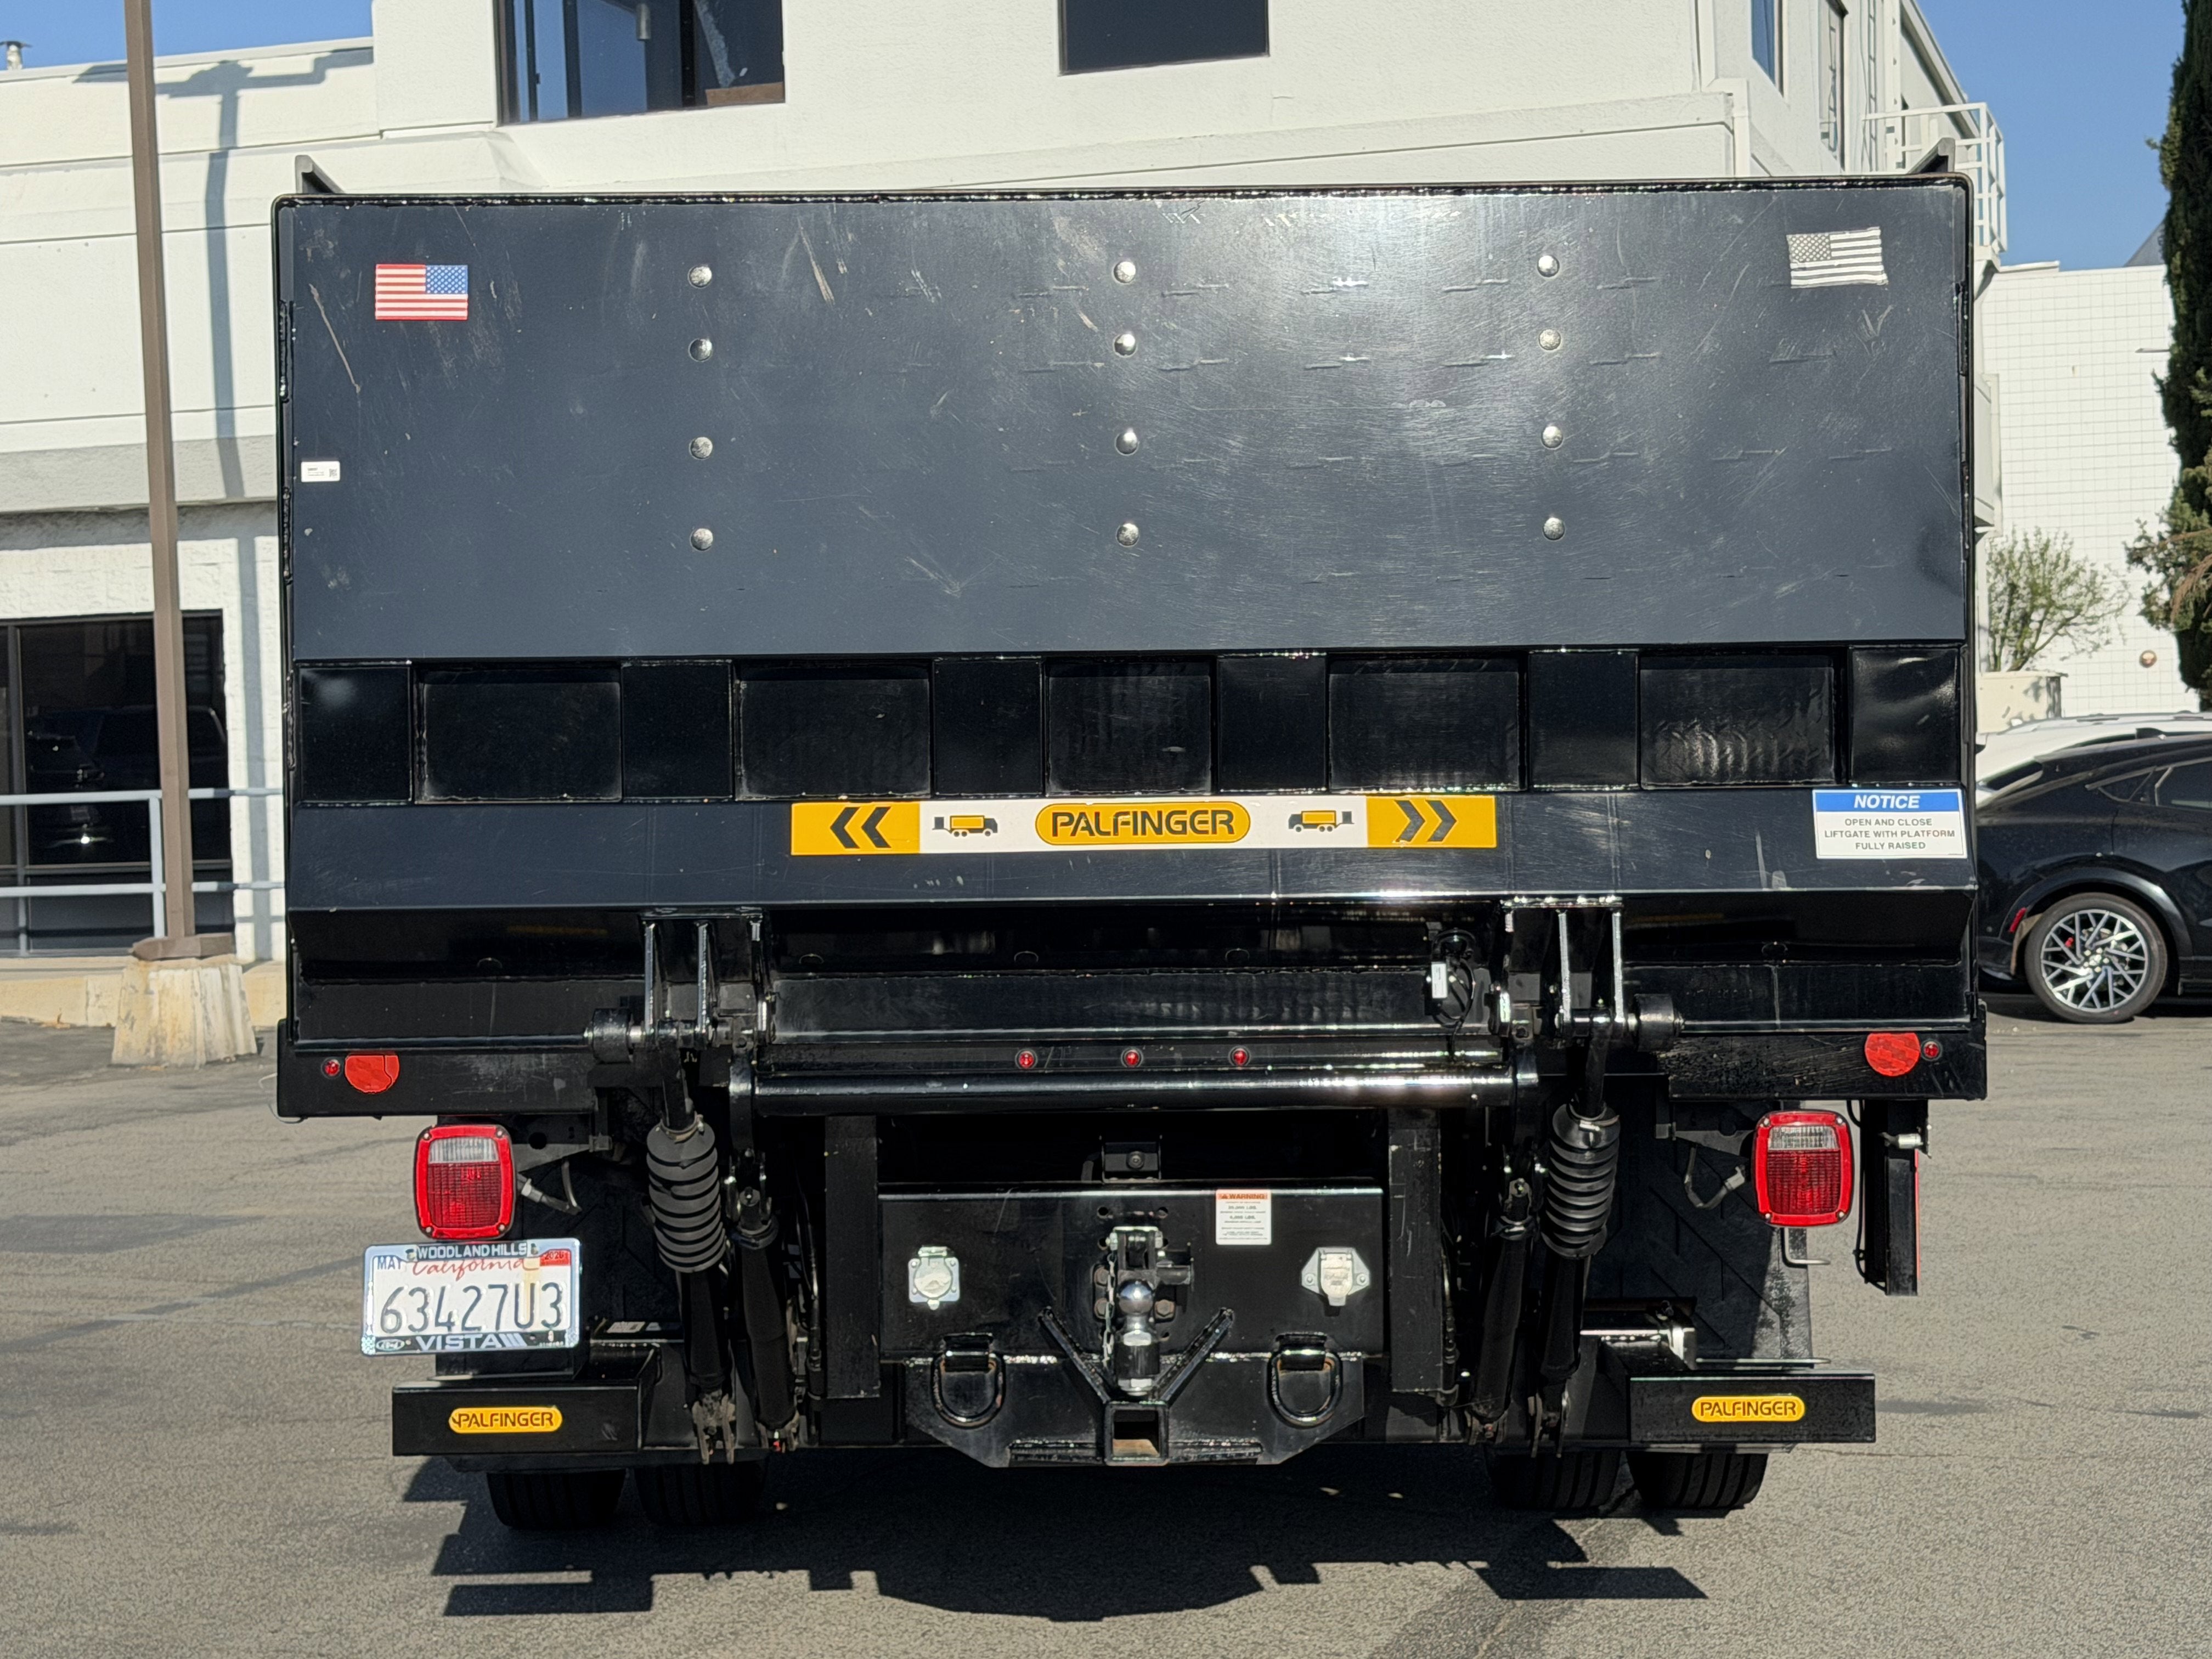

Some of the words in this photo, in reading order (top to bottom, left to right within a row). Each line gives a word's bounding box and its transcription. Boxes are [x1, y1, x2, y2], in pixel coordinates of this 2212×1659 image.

[1854, 795, 1921, 809] NOTICE
[1052, 809, 1235, 837] PALFINGER
[1844, 818, 1872, 826] OPEN
[1874, 818, 1895, 826] AND
[1824, 830, 1870, 838] LIFTGATE
[417, 1244, 490, 1259] WOODLAND
[491, 1243, 527, 1256] HILLS
[413, 1258, 540, 1282] California
[380, 1282, 563, 1334] 63427U3
[415, 1333, 503, 1351] VISTA
[1701, 1401, 1796, 1417] PALFINGER
[458, 1412, 554, 1428] PALFINGER
